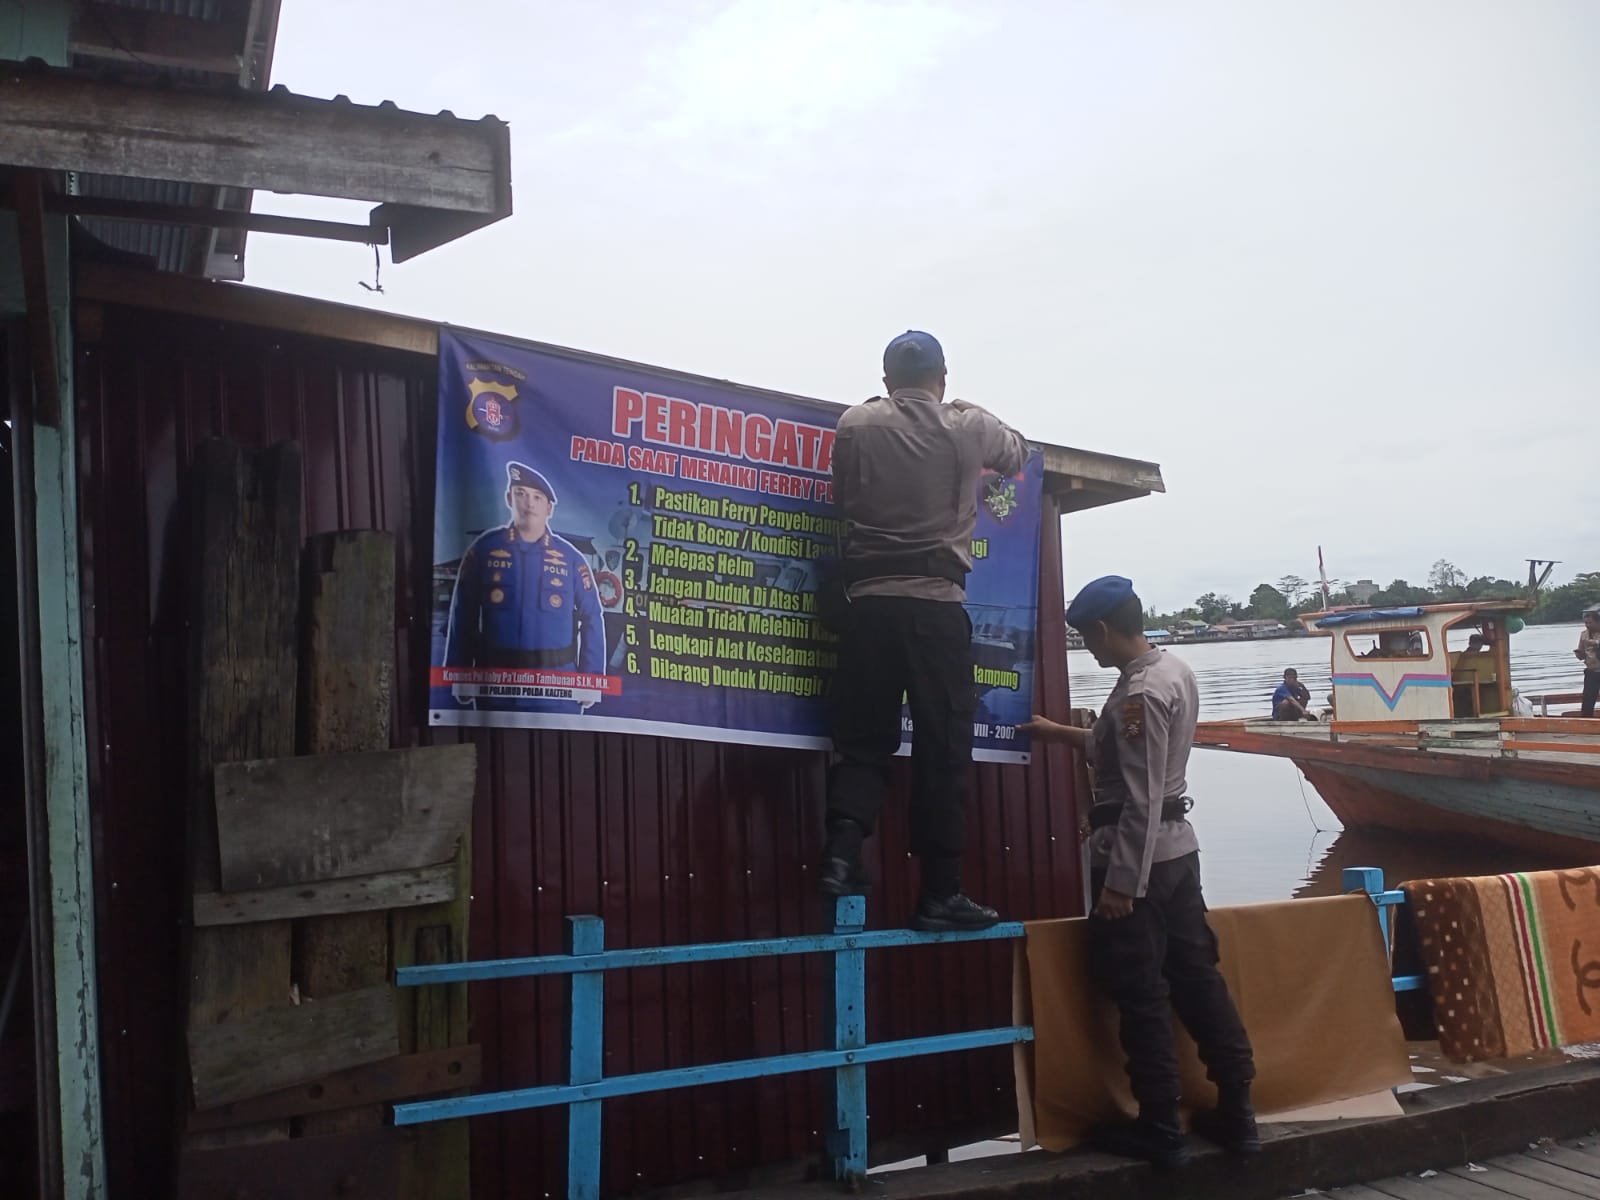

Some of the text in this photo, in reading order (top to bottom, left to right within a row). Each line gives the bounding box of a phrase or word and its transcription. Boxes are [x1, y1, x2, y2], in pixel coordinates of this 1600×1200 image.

[612, 385, 837, 475] PERINGATA
[570, 435, 835, 504] PADA SAAT MENAIKI FERRY PE
[629, 483, 641, 505] 1.
[655, 487, 719, 517] Pastikan
[721, 498, 757, 525] Ferry
[654, 516, 695, 539] Tidak
[697, 523, 739, 548] Bocor
[741, 529, 749, 549] /
[751, 531, 803, 557] Kondisi
[543, 565, 568, 577] POLRI
[625, 540, 754, 577] 2. Melepas Helm
[624, 568, 637, 591] 3.
[650, 573, 702, 600] Jangan
[705, 580, 750, 606] Duduk
[753, 586, 767, 607] Di
[769, 588, 800, 611] Atas
[625, 597, 637, 618] 4.
[649, 601, 703, 627] Muatan
[706, 608, 745, 632] Tidak
[748, 614, 809, 639] Melebihi
[626, 624, 1019, 689] 5. Lengkapi Alat Keselamatan lampung
[627, 652, 640, 674] 6.
[650, 657, 710, 686] Dilarang
[713, 665, 756, 690] Duduk
[759, 673, 824, 697] Dipinggir
[522, 687, 544, 697] POLDA
[545, 688, 573, 698] KALTENG
[995, 725, 1015, 739] 2007
